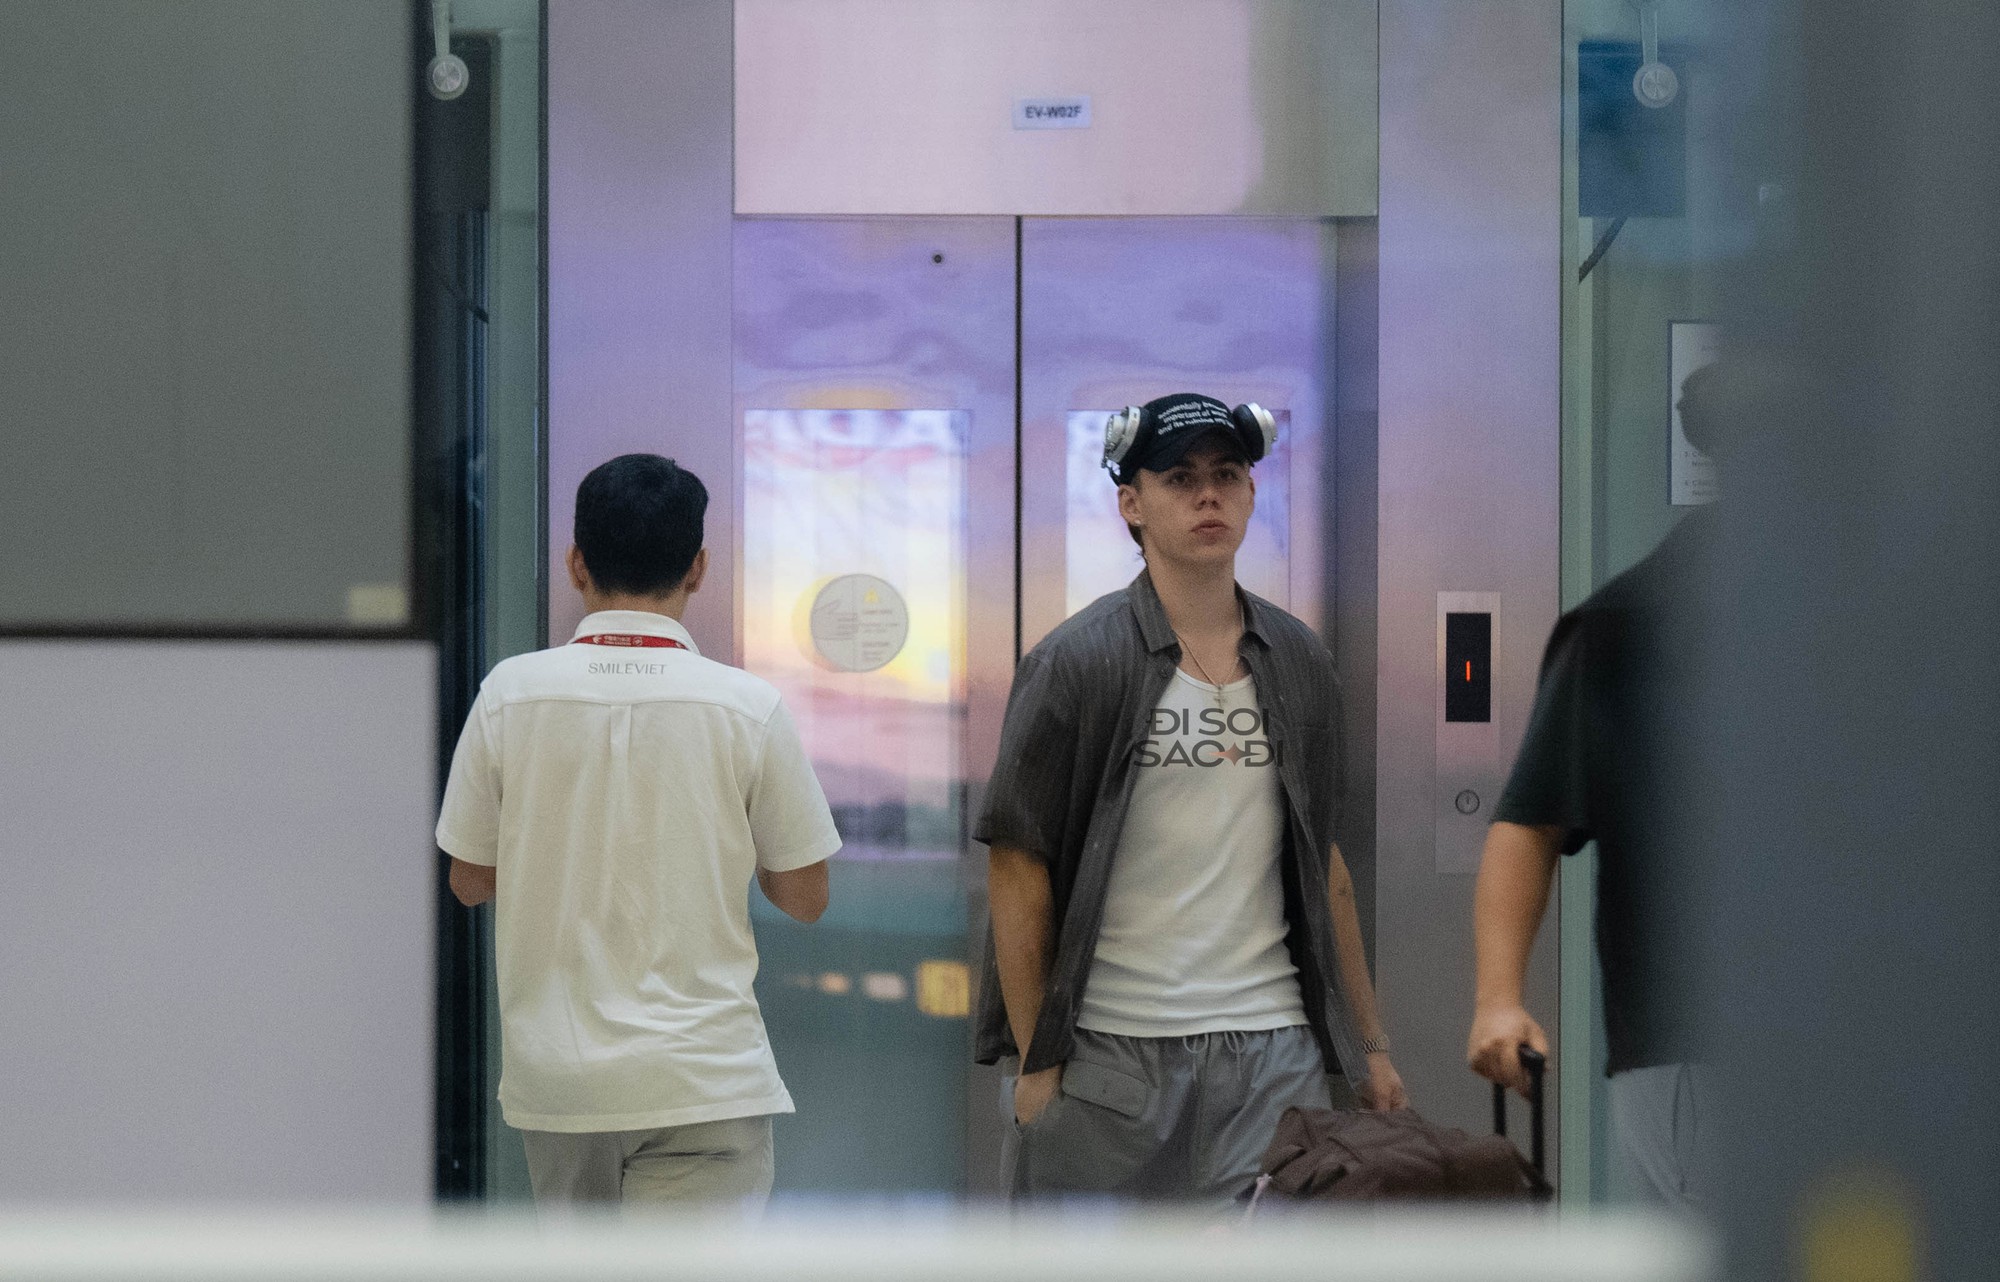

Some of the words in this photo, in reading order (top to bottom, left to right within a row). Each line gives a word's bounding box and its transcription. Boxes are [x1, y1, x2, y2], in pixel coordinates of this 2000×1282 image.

[1025, 105, 1081, 118] EV-W02F
[1158, 423, 1173, 435] and
[588, 662, 667, 675] SMILEVIET
